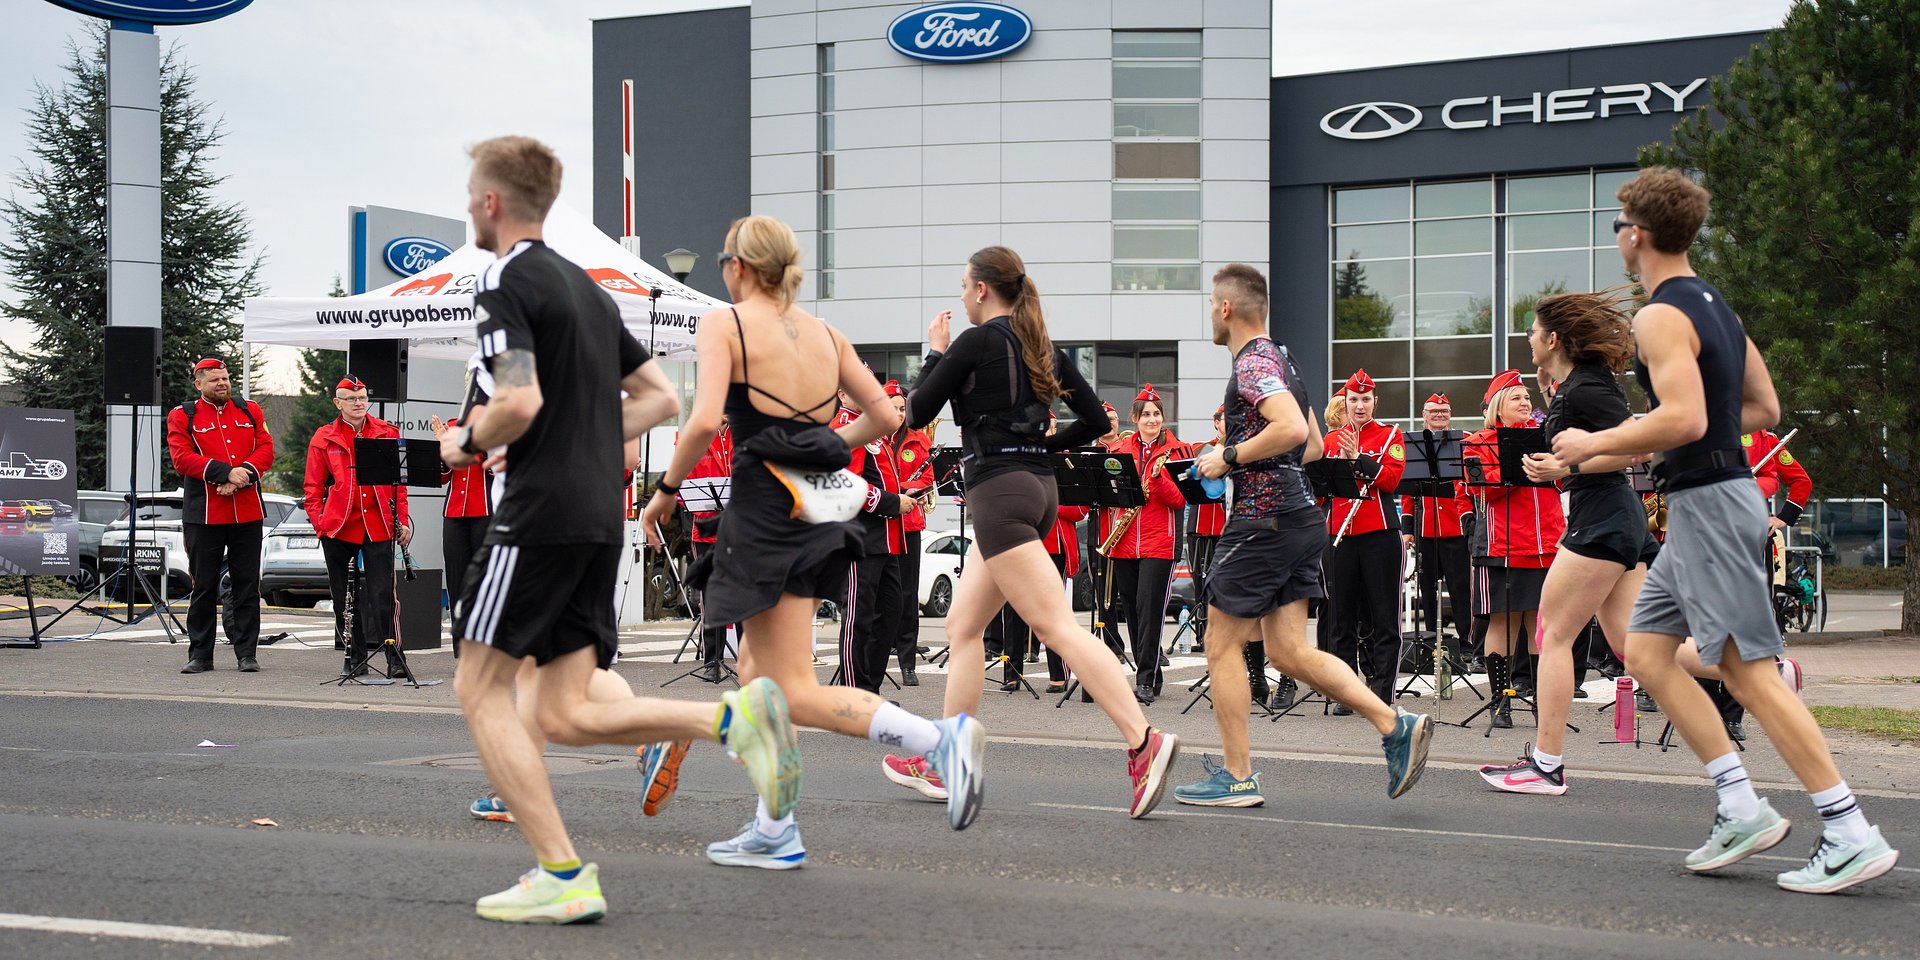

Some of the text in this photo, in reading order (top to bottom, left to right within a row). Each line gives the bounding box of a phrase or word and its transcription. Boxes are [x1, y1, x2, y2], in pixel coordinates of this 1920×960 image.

[914, 12, 1002, 49] Ford
[1441, 78, 1707, 130] CHERY
[804, 472, 853, 490] 9288
[1230, 781, 1256, 793] HOKA
